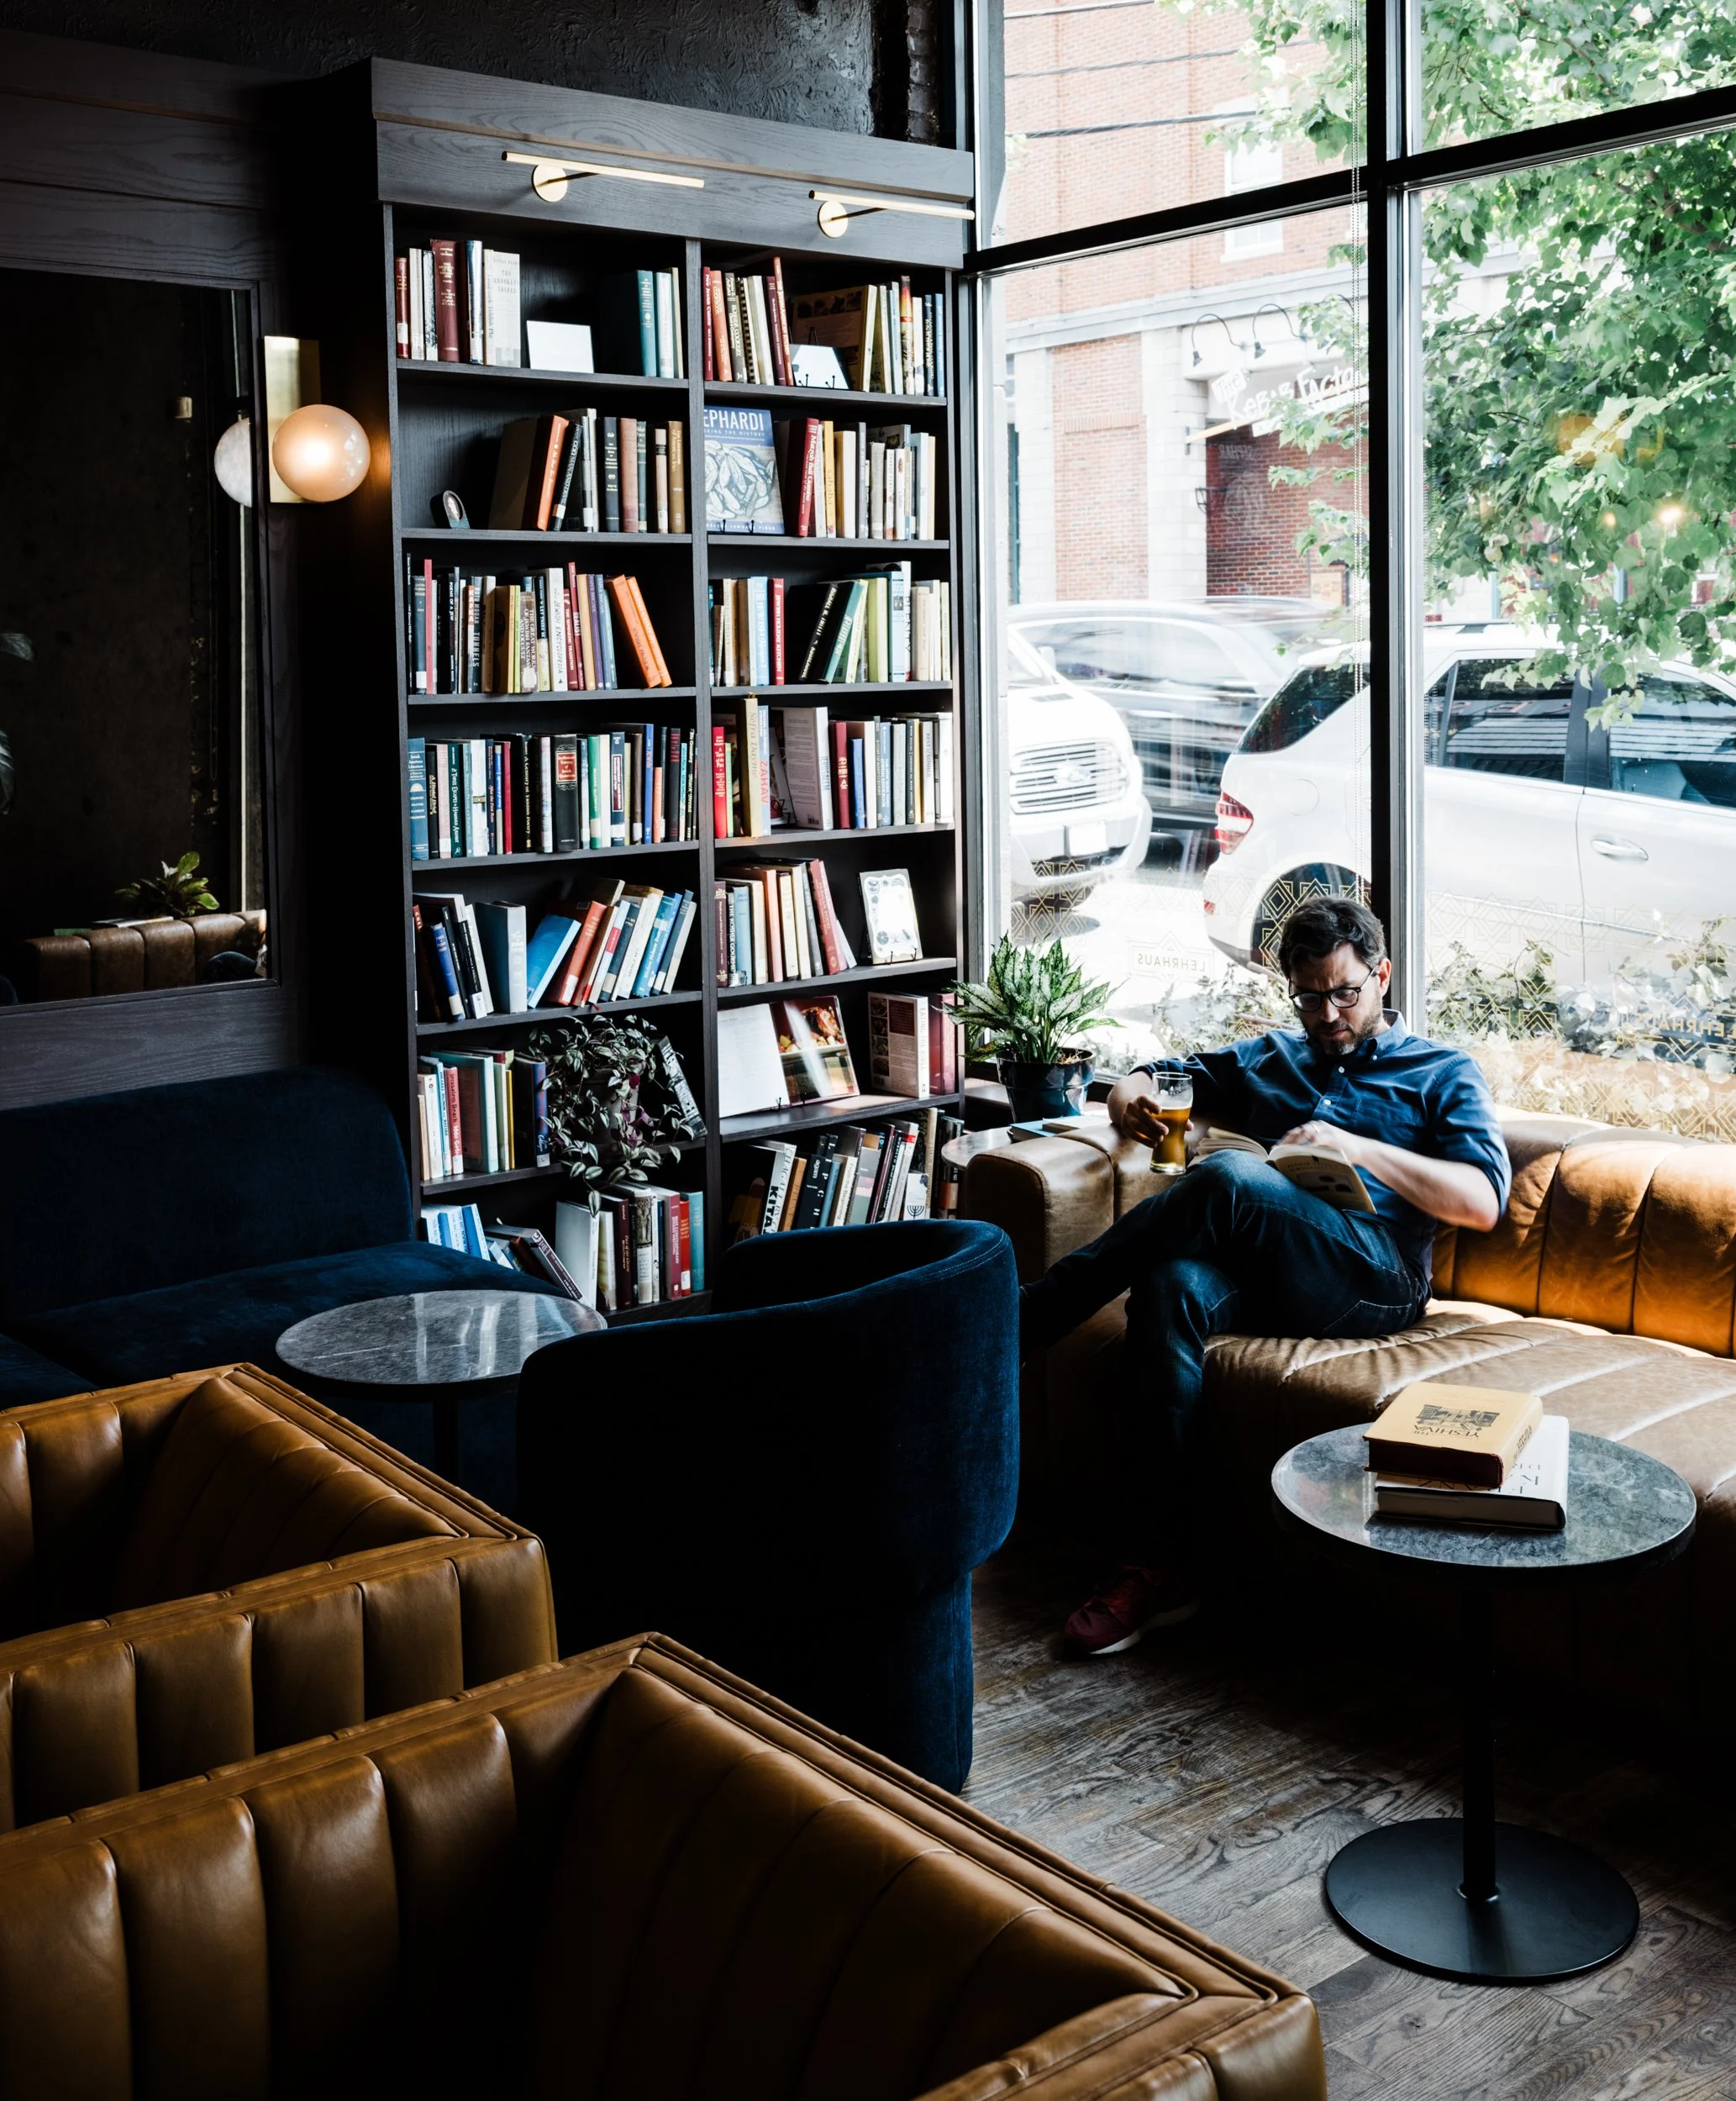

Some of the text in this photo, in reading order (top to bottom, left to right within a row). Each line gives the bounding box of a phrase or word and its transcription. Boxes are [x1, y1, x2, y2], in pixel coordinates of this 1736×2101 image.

[704, 409, 765, 430] EPHARDI
[808, 434, 816, 461] Matzoh
[560, 487, 571, 506] DEVIL
[524, 608, 529, 617] OF
[760, 761, 769, 805] ZAHAV
[820, 756, 829, 790] JERUSALEM
[778, 1148, 792, 1199] CHAGALL
[813, 1160, 821, 1178] agam
[838, 1190, 848, 1219] Beginning
[1413, 1424, 1480, 1439] YESHIVA
